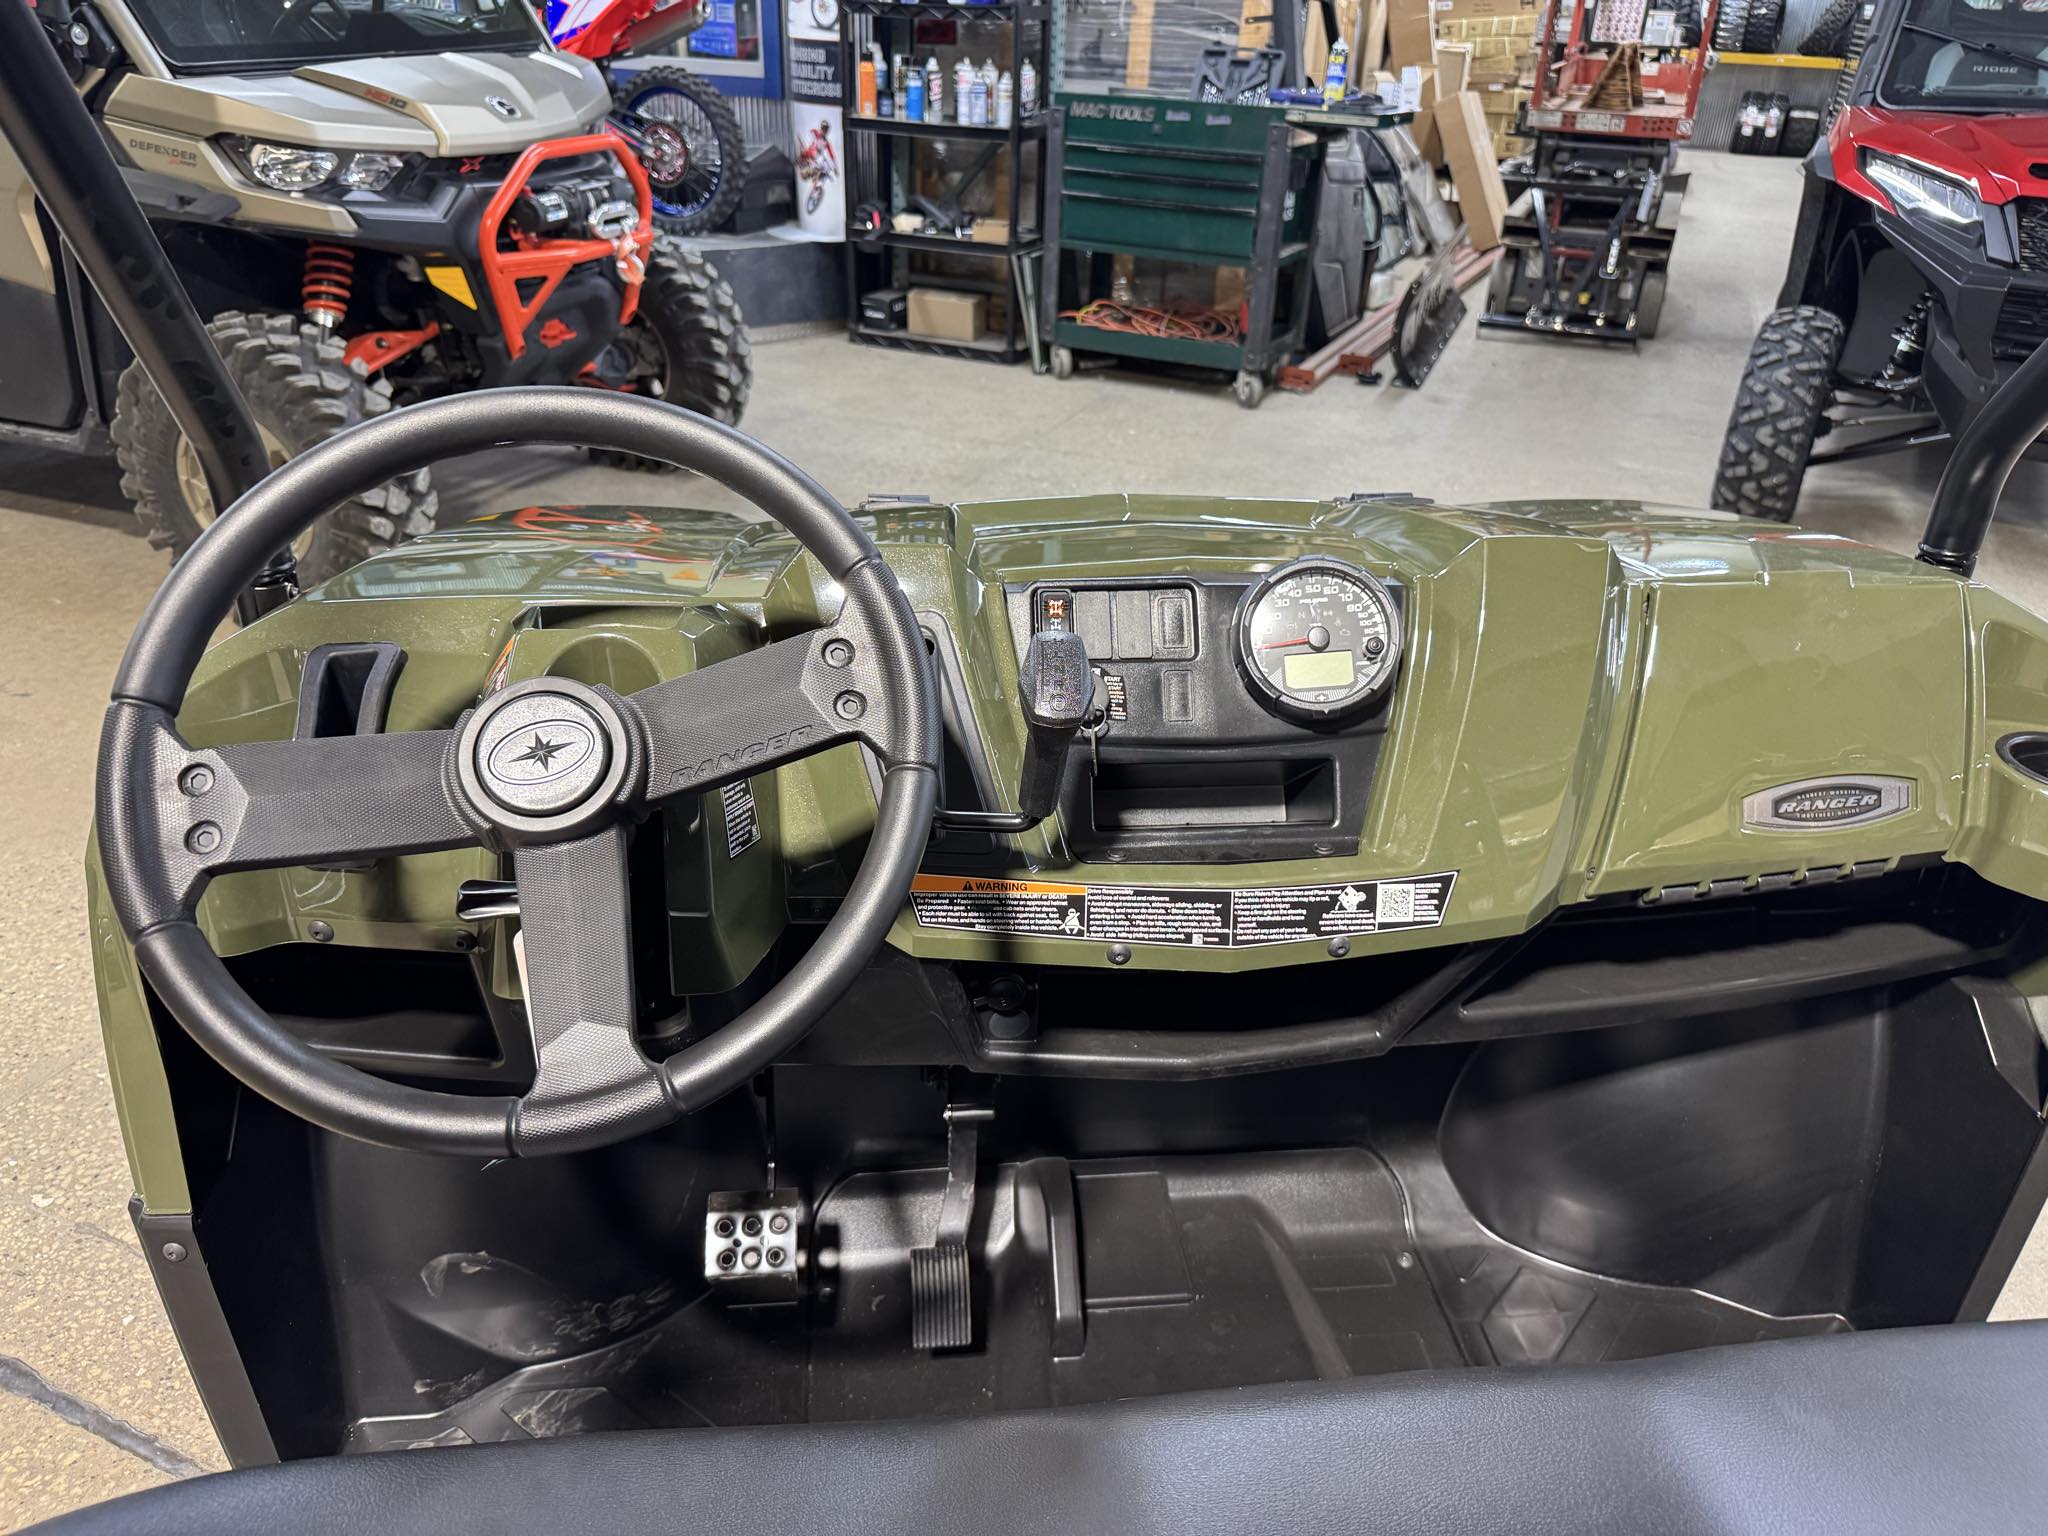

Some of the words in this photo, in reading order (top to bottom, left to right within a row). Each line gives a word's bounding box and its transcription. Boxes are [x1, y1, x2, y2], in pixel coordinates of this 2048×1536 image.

[1973, 64, 2018, 73] RIDGE
[1070, 101, 1108, 118] MAC
[1109, 104, 1155, 122] TOOLS
[129, 139, 197, 161] DEFENDER
[1288, 589, 1302, 598] 40
[1305, 584, 1321, 594] 50
[1323, 586, 1339, 594] 60
[1338, 593, 1353, 602] 70
[1274, 598, 1288, 607] 30
[1347, 604, 1363, 612] 80
[669, 725, 813, 785] RANGER
[1778, 795, 1878, 813] RANGER
[975, 882, 1028, 891] WARNING
